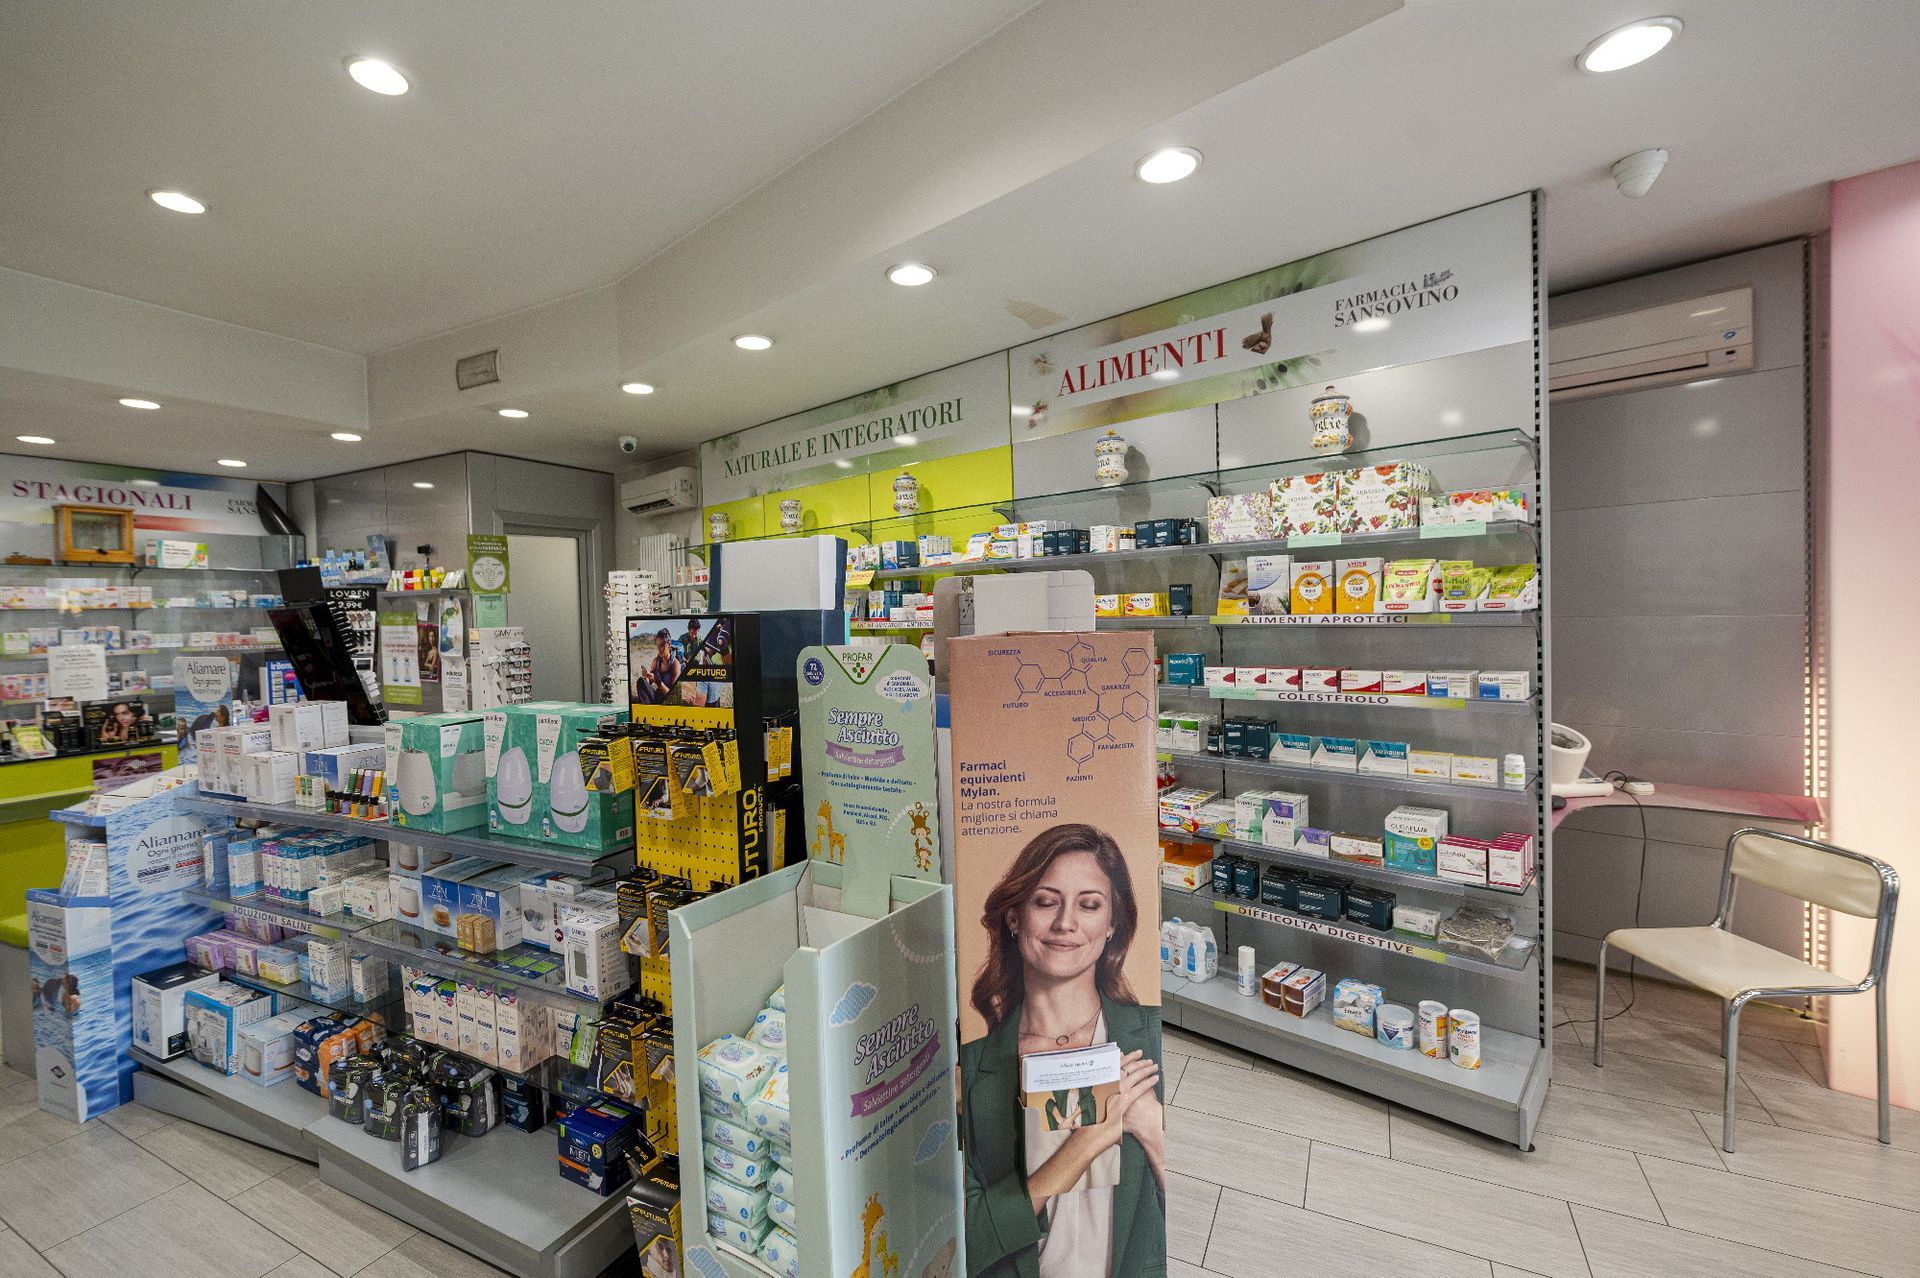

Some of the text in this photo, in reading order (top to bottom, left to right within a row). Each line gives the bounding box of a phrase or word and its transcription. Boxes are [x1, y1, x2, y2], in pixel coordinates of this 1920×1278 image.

[1335, 281, 1418, 311] FARMACIA
[1334, 284, 1459, 328] SANSOVINO
[1057, 327, 1228, 398] ALIMENTI
[724, 397, 964, 479] NATURALE E INTEGRATORI
[12, 480, 192, 511] STAGIONALI
[1241, 615, 1409, 624] ALIMENTI APROTEICI
[842, 652, 873, 662] PROFAR
[988, 649, 1021, 657] SICUREZZA
[1081, 655, 1107, 664] QUALITÀ
[187, 660, 226, 675] Aliamare
[696, 668, 727, 677] FUTURO
[1101, 683, 1131, 692] GARANZIE
[1278, 691, 1389, 704] COLESTEROLO
[828, 707, 883, 728] Sempre
[837, 726, 900, 747] Asciutto
[642, 746, 664, 754] FUTURO
[1098, 742, 1135, 751] FARMACISTA
[960, 759, 1006, 772] Farmaci
[960, 772, 1026, 786] equivalenti
[1066, 774, 1094, 782] PAZIENTI
[961, 786, 1000, 800] Mylan.
[961, 795, 1056, 811] La nostra formula
[961, 809, 1058, 826] migliore si chiama
[743, 788, 760, 880] UTURO
[961, 824, 1023, 836] attenzione.
[136, 829, 207, 850] Aliamare
[147, 840, 198, 858] Ogni giorno
[232, 905, 313, 932] SOLUZIONI SALINE
[1238, 906, 1414, 955] DIFFICOLTA' DIGESTIVE
[607, 1030, 629, 1040] FUTURO
[854, 1003, 919, 1065] Sempre
[866, 1018, 935, 1085] Asciutto
[863, 1052, 931, 1112] Salviettine detergenti
[845, 1131, 872, 1159] Profumo
[879, 1113, 894, 1128] talco
[859, 1104, 919, 1160] Dermatologicamente
[569, 1146, 591, 1162] MEN
[657, 1179, 679, 1190] FUTURO
[639, 1209, 668, 1225] FUTURO
